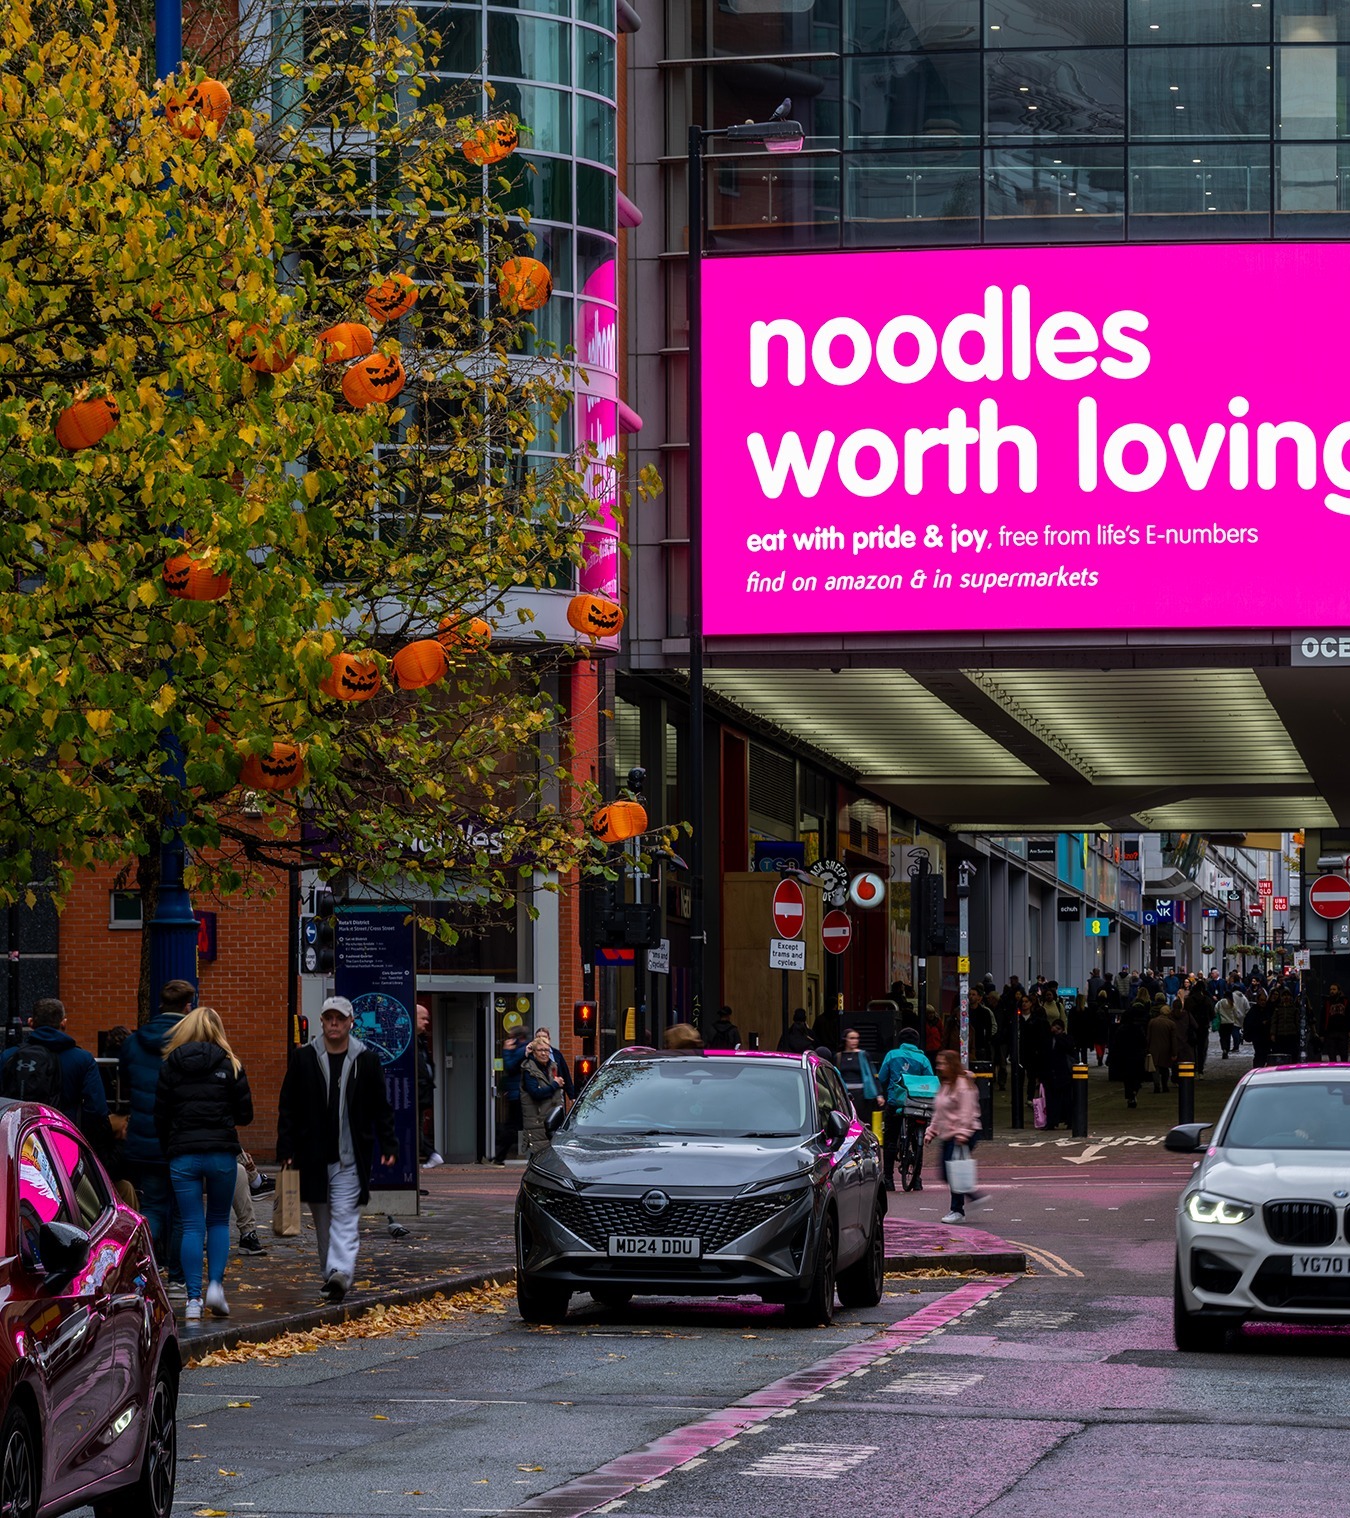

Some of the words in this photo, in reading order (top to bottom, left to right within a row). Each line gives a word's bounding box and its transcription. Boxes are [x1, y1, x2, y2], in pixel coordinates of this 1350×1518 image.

[749, 285, 1151, 388] noodles
[746, 398, 1038, 499] worth
[746, 528, 788, 553] eat
[792, 526, 845, 551] with
[852, 524, 917, 556] pride
[923, 525, 944, 549] &
[950, 524, 993, 554] joy,
[998, 526, 1039, 547] free
[1043, 525, 1091, 546] from
[1097, 523, 1141, 545] life's
[1146, 522, 1259, 545] E-numbers
[746, 570, 786, 593] find
[792, 577, 818, 592] on
[824, 575, 903, 591] amazon
[909, 569, 928, 589] &
[932, 568, 953, 589] in
[959, 566, 1099, 594] supermarkets
[825, 859, 848, 878] SHEEP
[1156, 907, 1172, 917] NK
[772, 950, 790, 959] trams
[791, 951, 803, 959] and
[777, 942, 799, 951] Except
[777, 958, 797, 967] cycles
[616, 1239, 656, 1254] MD24
[662, 1239, 692, 1254] DDU
[1300, 1257, 1342, 1273] YG70
